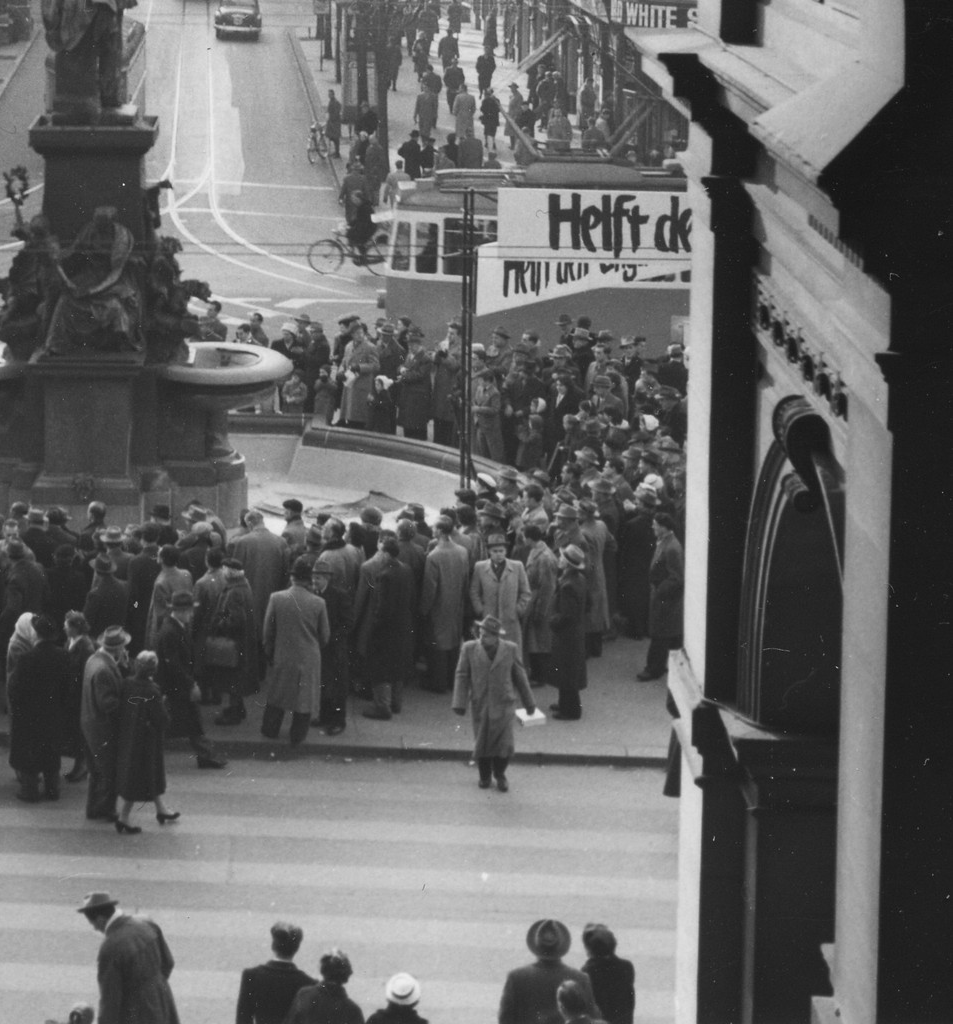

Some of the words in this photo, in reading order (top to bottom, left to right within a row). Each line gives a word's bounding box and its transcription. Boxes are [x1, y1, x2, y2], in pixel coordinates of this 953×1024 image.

[626, 2, 677, 28] WHITE
[549, 193, 649, 258] Helft
[654, 195, 692, 254] de
